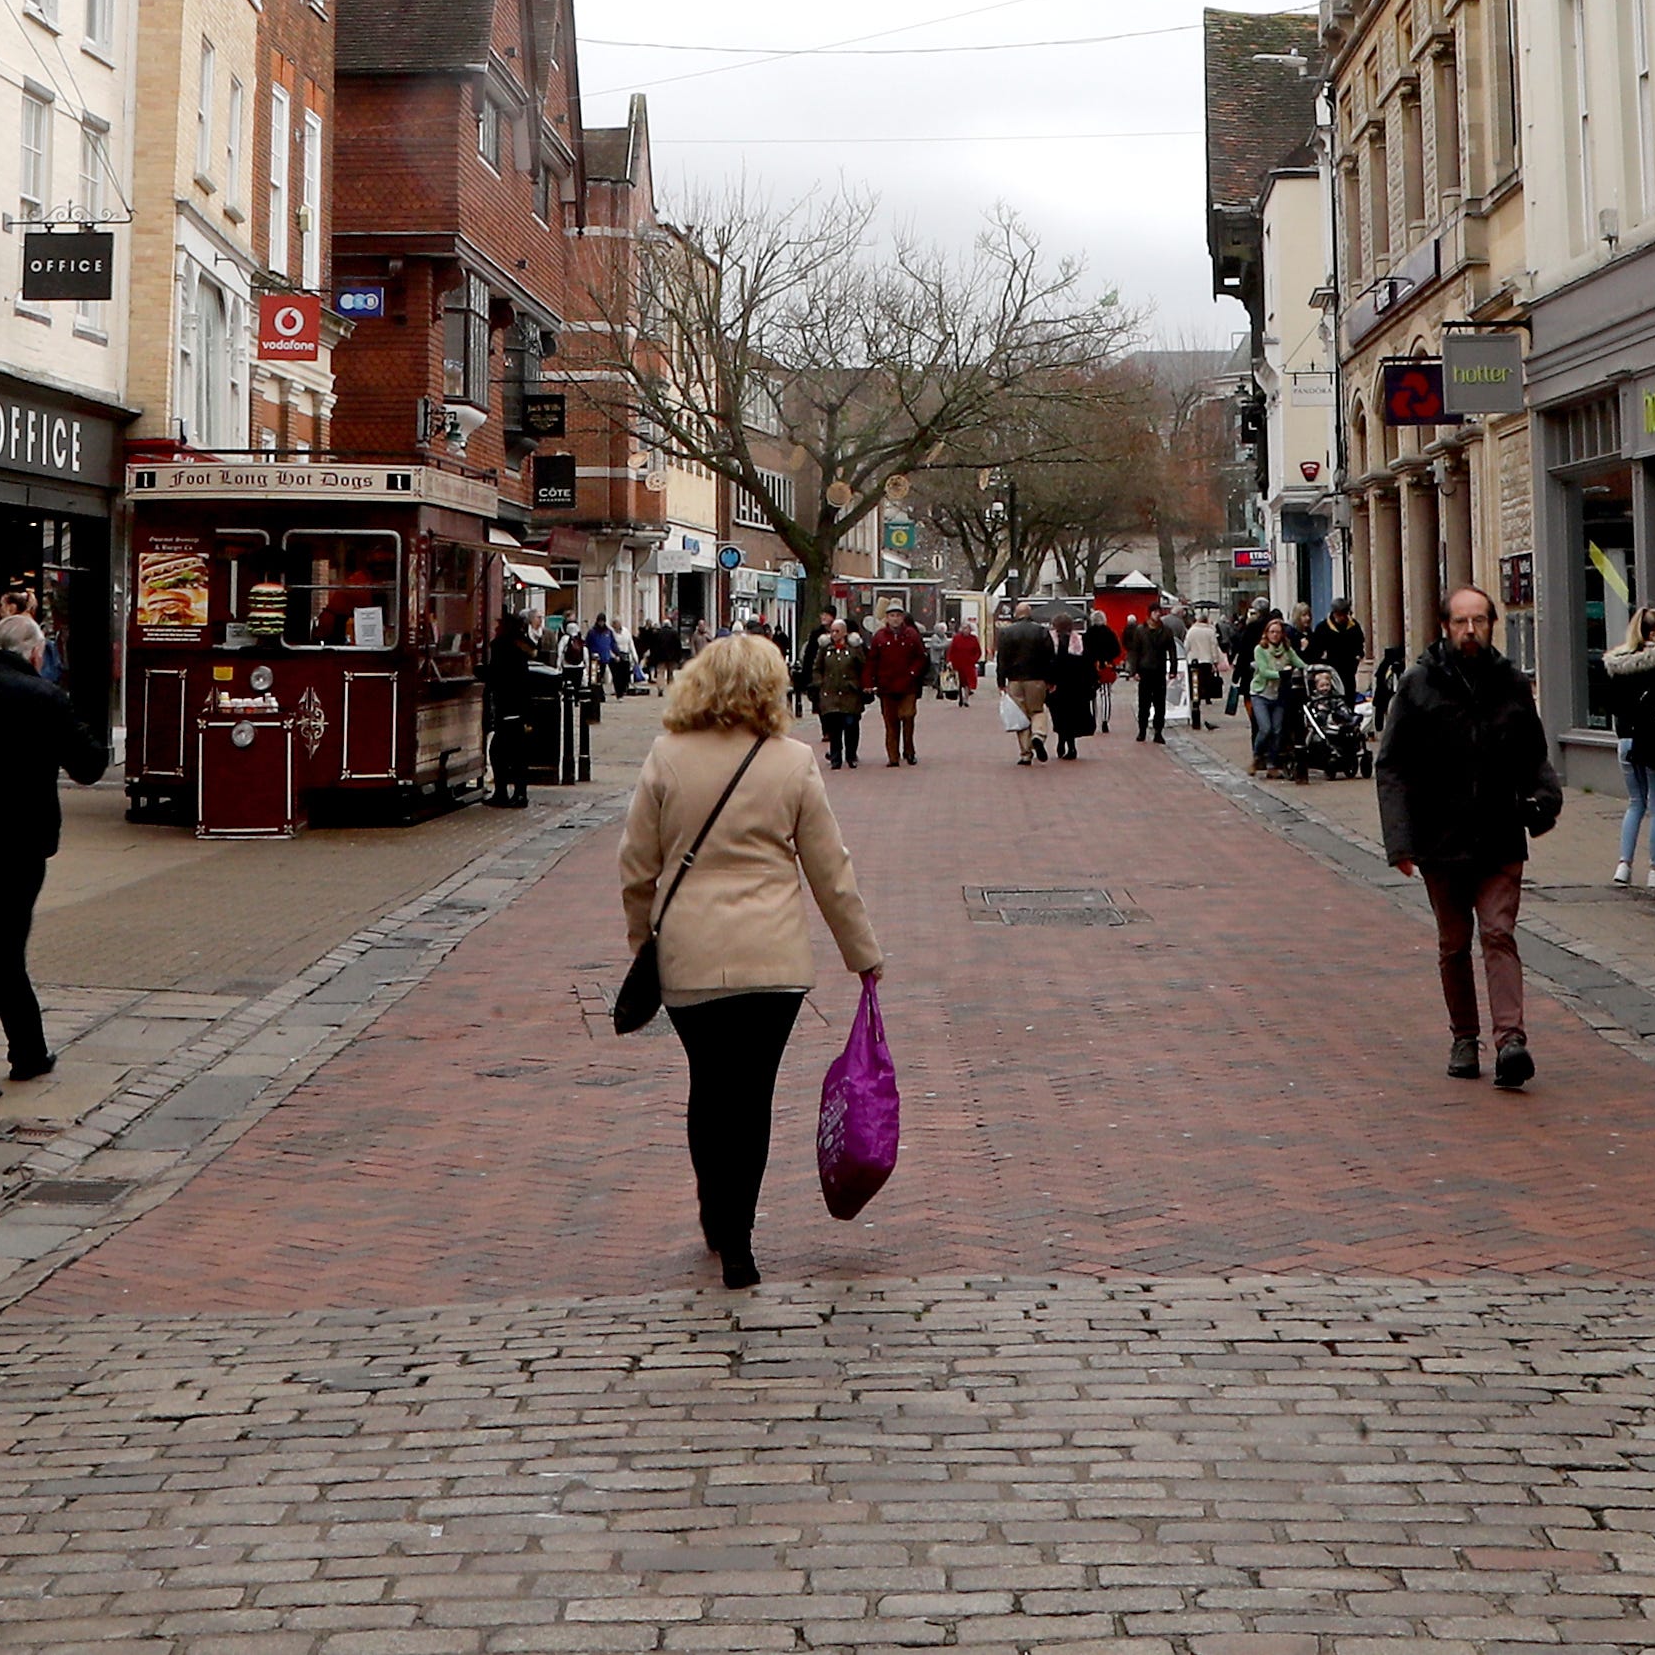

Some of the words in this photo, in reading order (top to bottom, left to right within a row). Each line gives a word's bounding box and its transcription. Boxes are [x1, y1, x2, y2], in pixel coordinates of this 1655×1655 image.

[29, 258, 105, 274] OFFICE
[261, 338, 316, 353] vodafone
[1452, 364, 1512, 384] hotter
[169, 470, 212, 488] Foot
[218, 468, 269, 489] Long
[275, 468, 313, 488] Hot
[319, 470, 375, 490] Dogs
[538, 486, 571, 498] CÔTE
